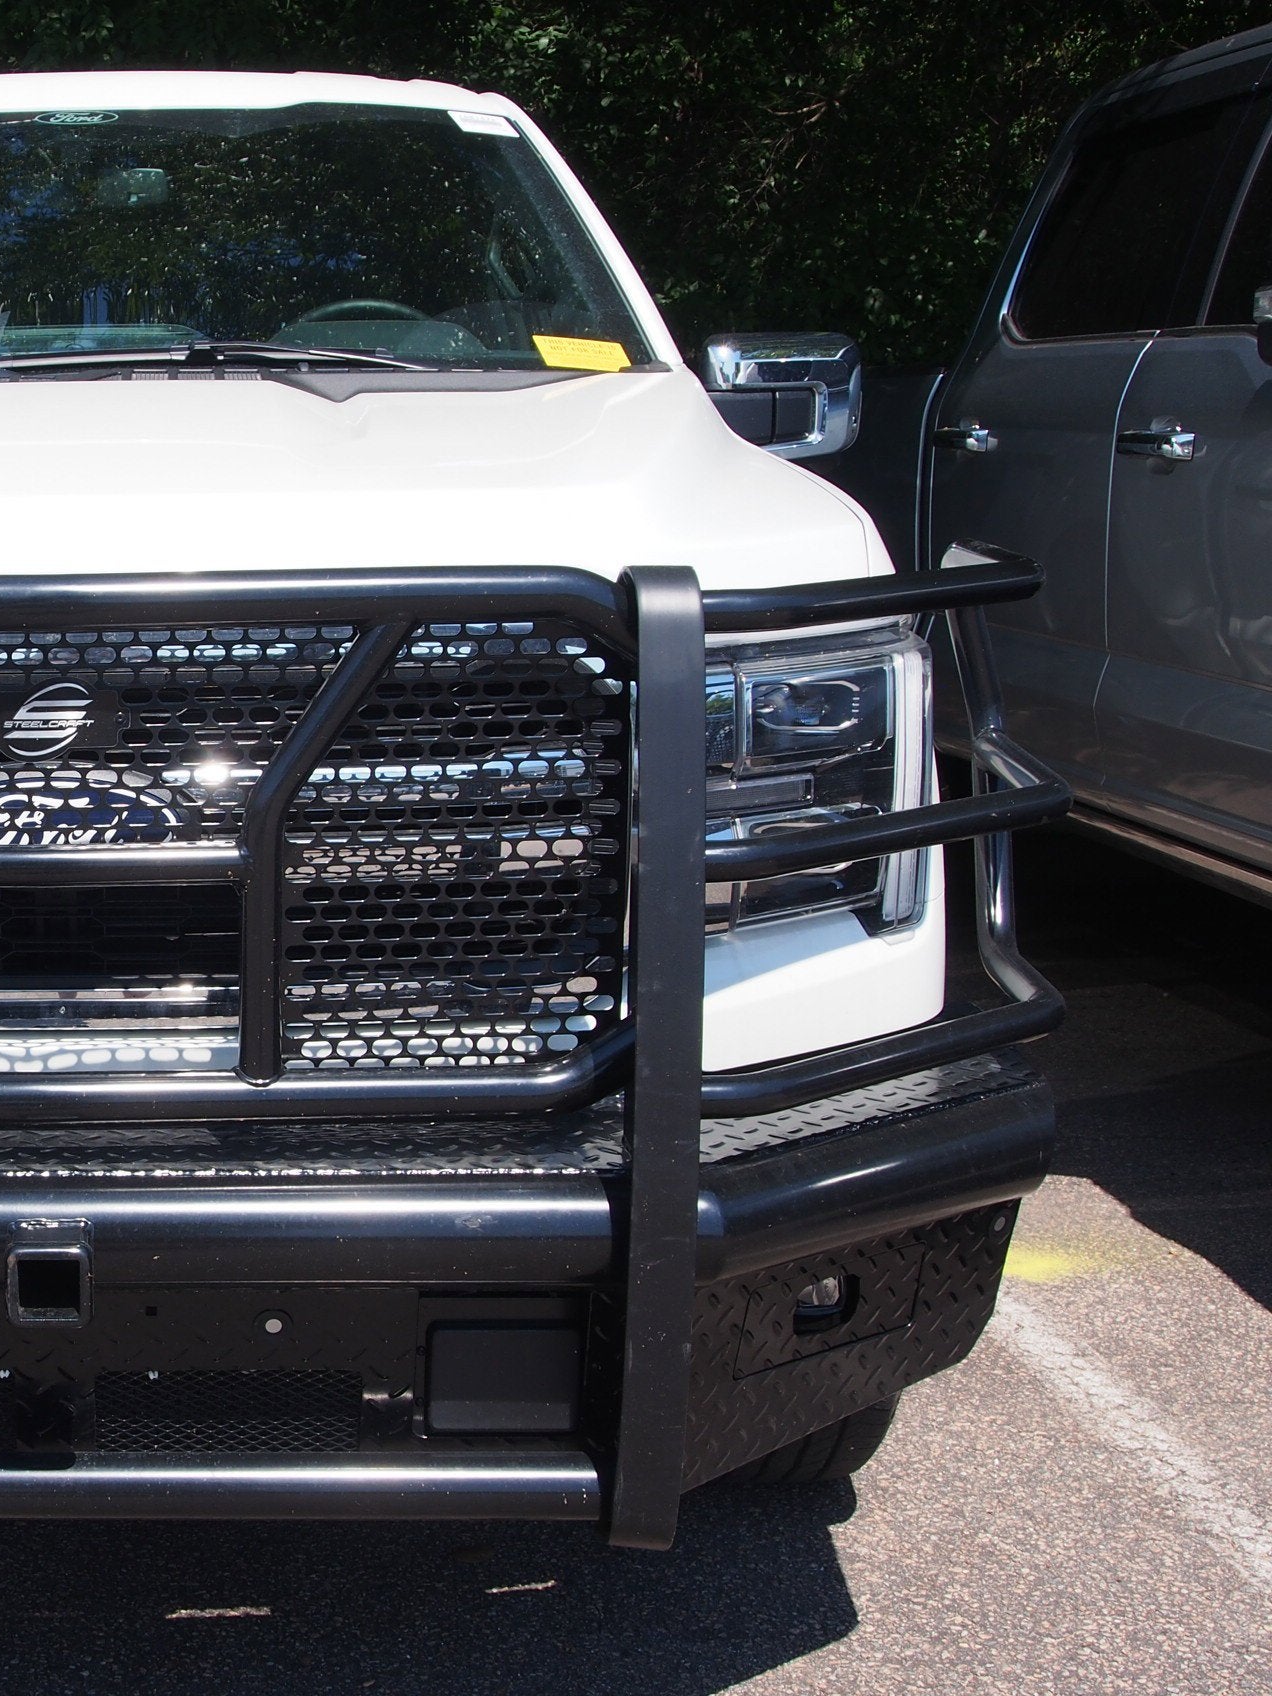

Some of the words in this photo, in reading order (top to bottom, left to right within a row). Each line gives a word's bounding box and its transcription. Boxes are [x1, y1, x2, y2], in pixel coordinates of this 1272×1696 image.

[49, 112, 104, 123] Ford
[567, 340, 602, 349] VEHICLE
[3, 719, 94, 728] STEELCRAFT
